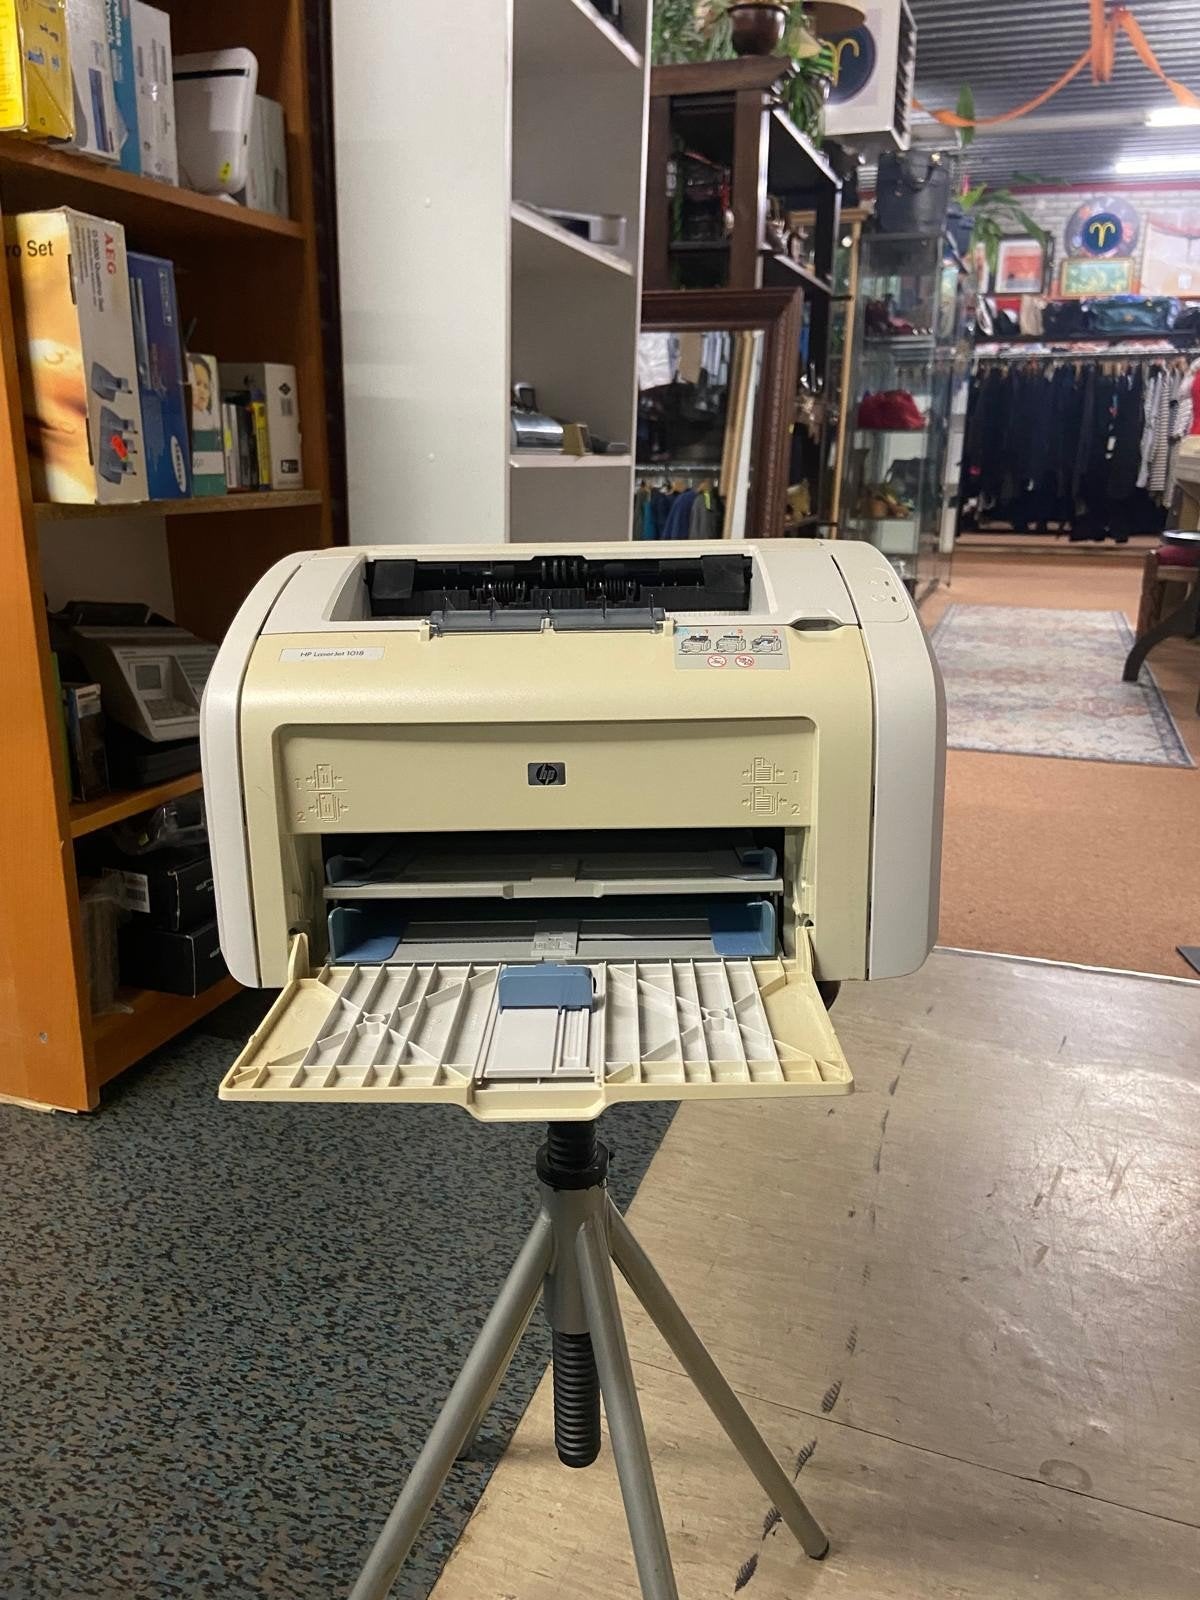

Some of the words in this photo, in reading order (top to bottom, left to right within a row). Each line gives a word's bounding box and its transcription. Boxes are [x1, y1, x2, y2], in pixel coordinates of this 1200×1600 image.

[27, 240, 53, 257] Set
[104, 231, 116, 275] AEG
[791, 803, 801, 816] 2
